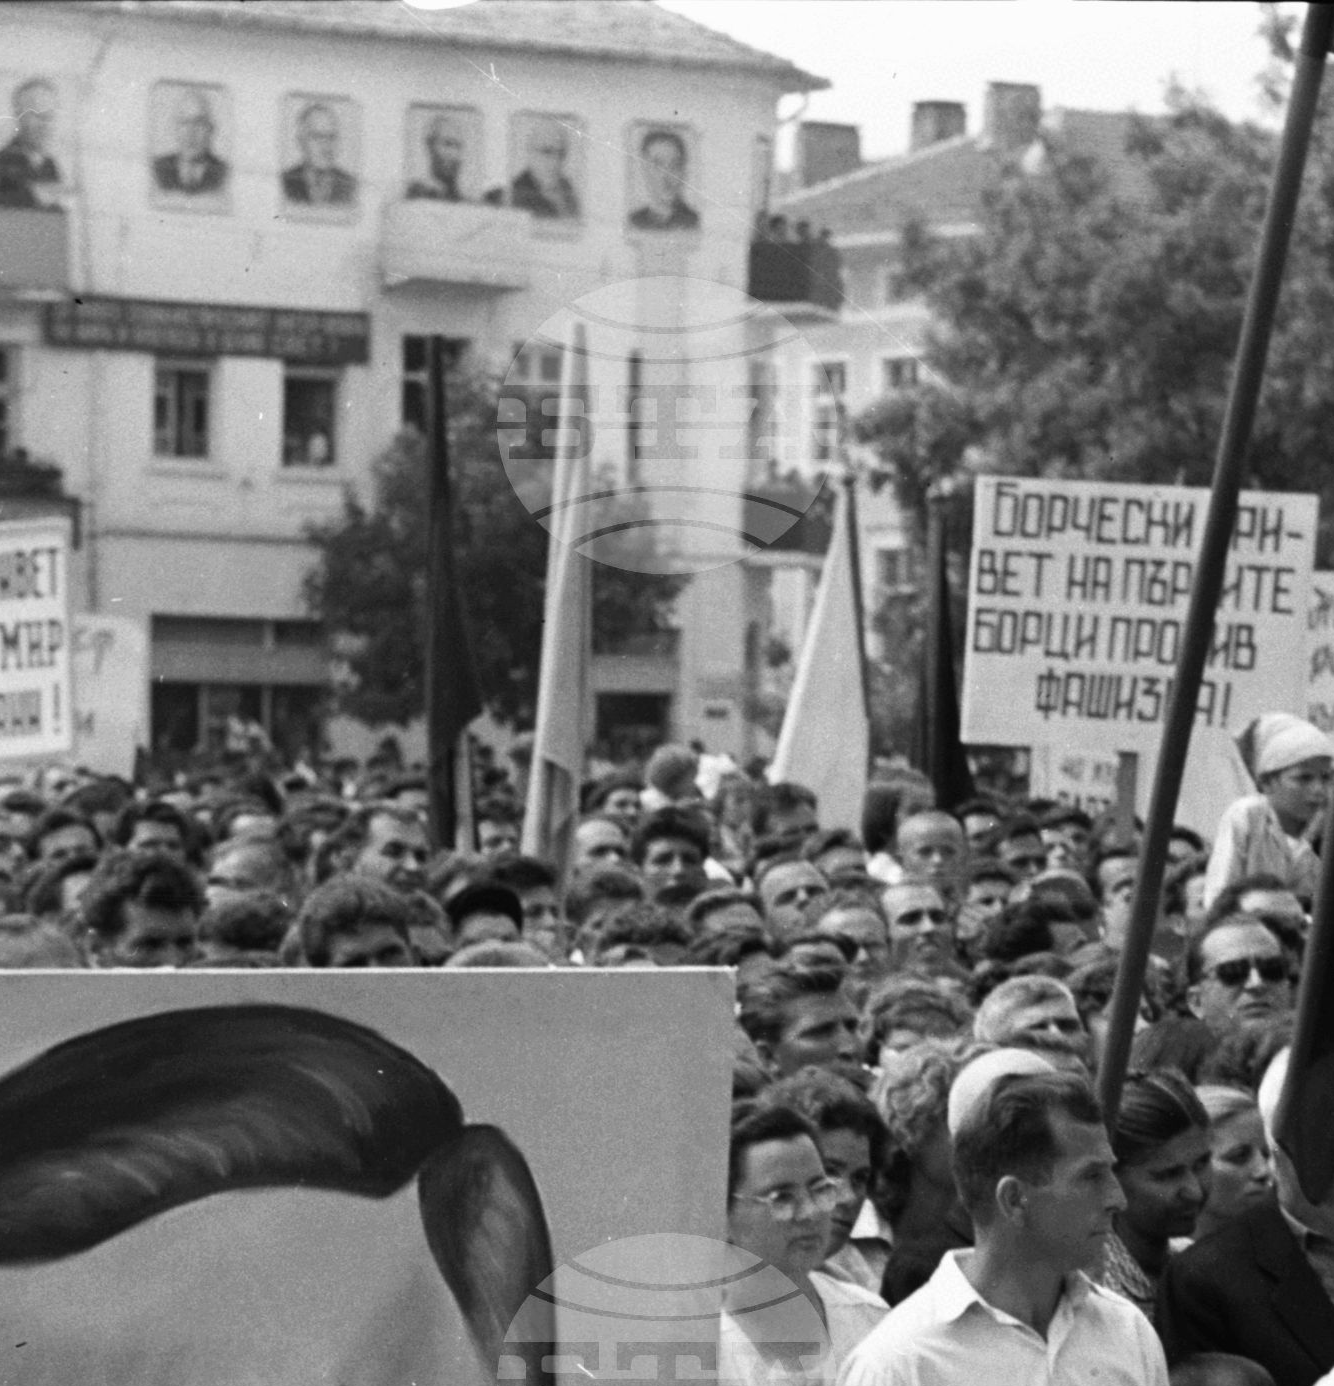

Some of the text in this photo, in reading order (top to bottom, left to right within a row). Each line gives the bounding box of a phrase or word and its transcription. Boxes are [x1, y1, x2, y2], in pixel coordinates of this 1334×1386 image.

[975, 548, 1054, 599] ВЕТ
[1067, 552, 1113, 602] НА
[1122, 556, 1297, 617] ПЪРИТЕ
[972, 605, 1099, 662] БОРЦИ
[1107, 613, 1257, 671] ПРОИВ
[1033, 664, 1234, 729] ФАШИЗА!
